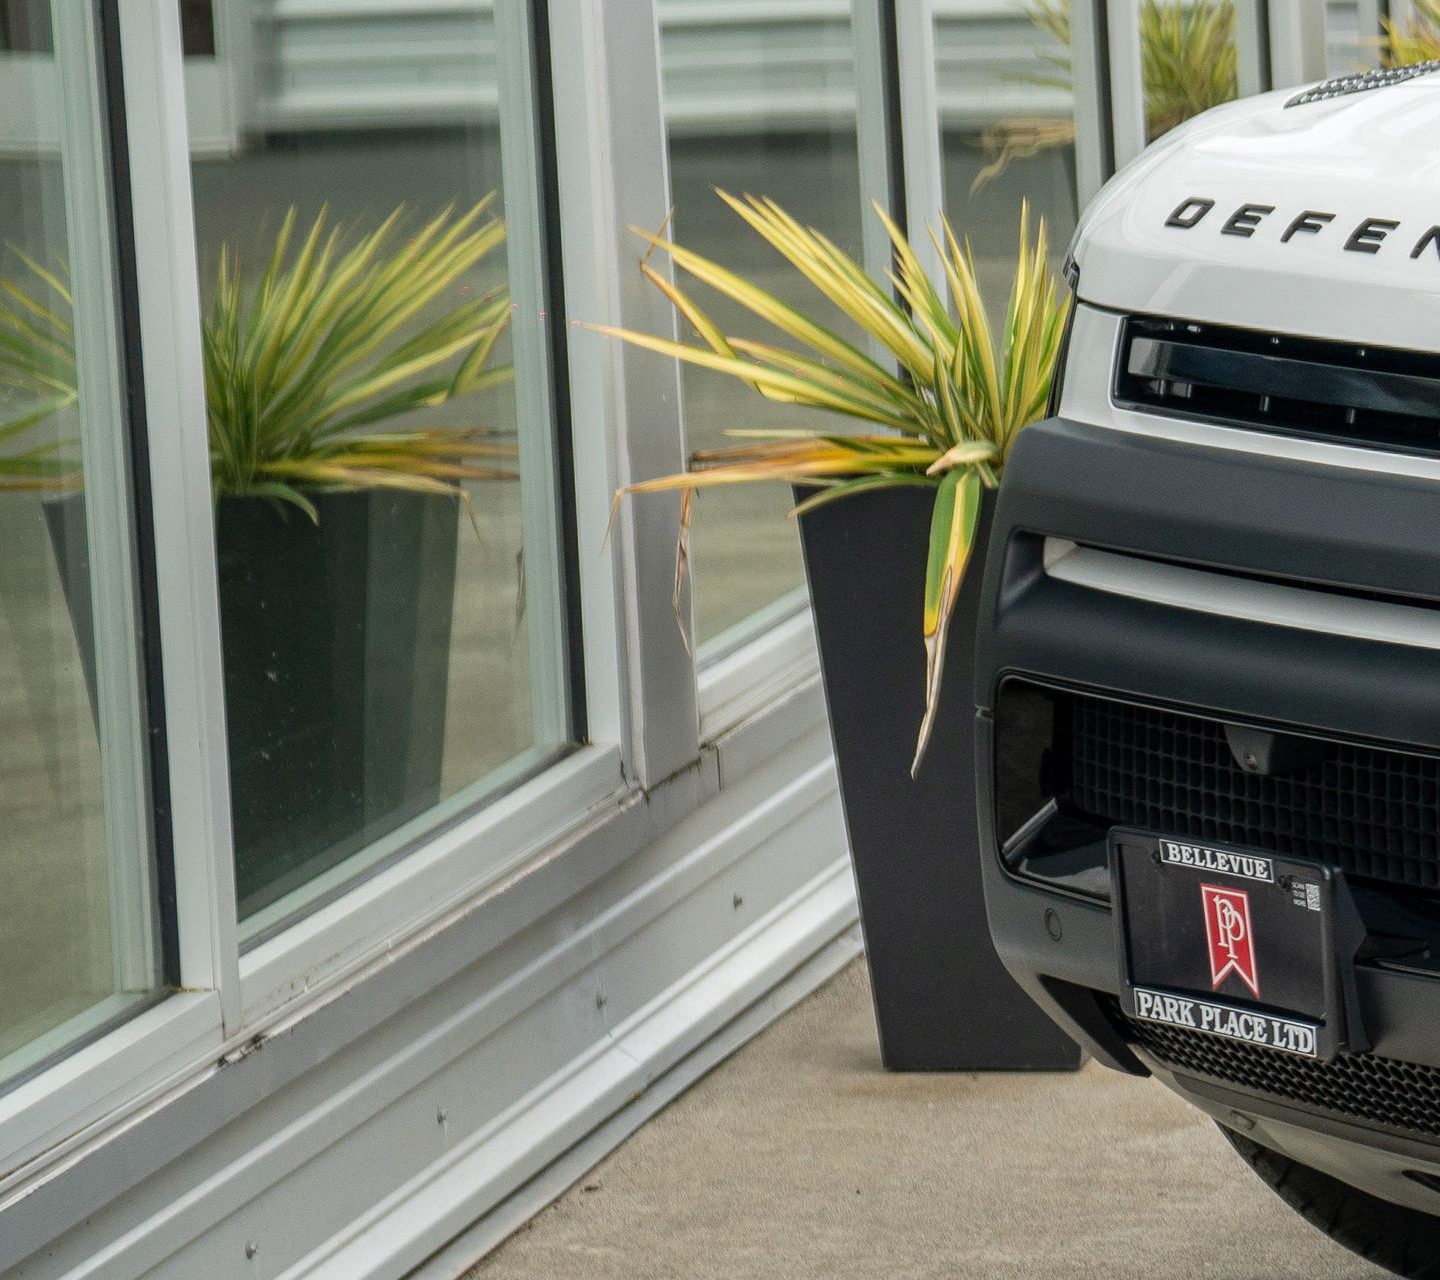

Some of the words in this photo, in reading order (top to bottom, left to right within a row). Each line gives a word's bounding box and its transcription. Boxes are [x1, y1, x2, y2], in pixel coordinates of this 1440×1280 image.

[1166, 843, 1269, 879] BELLEVUE
[1138, 991, 1197, 1028] PARK
[1200, 1003, 1267, 1043] PLACE
[1272, 1021, 1314, 1053] LTD
